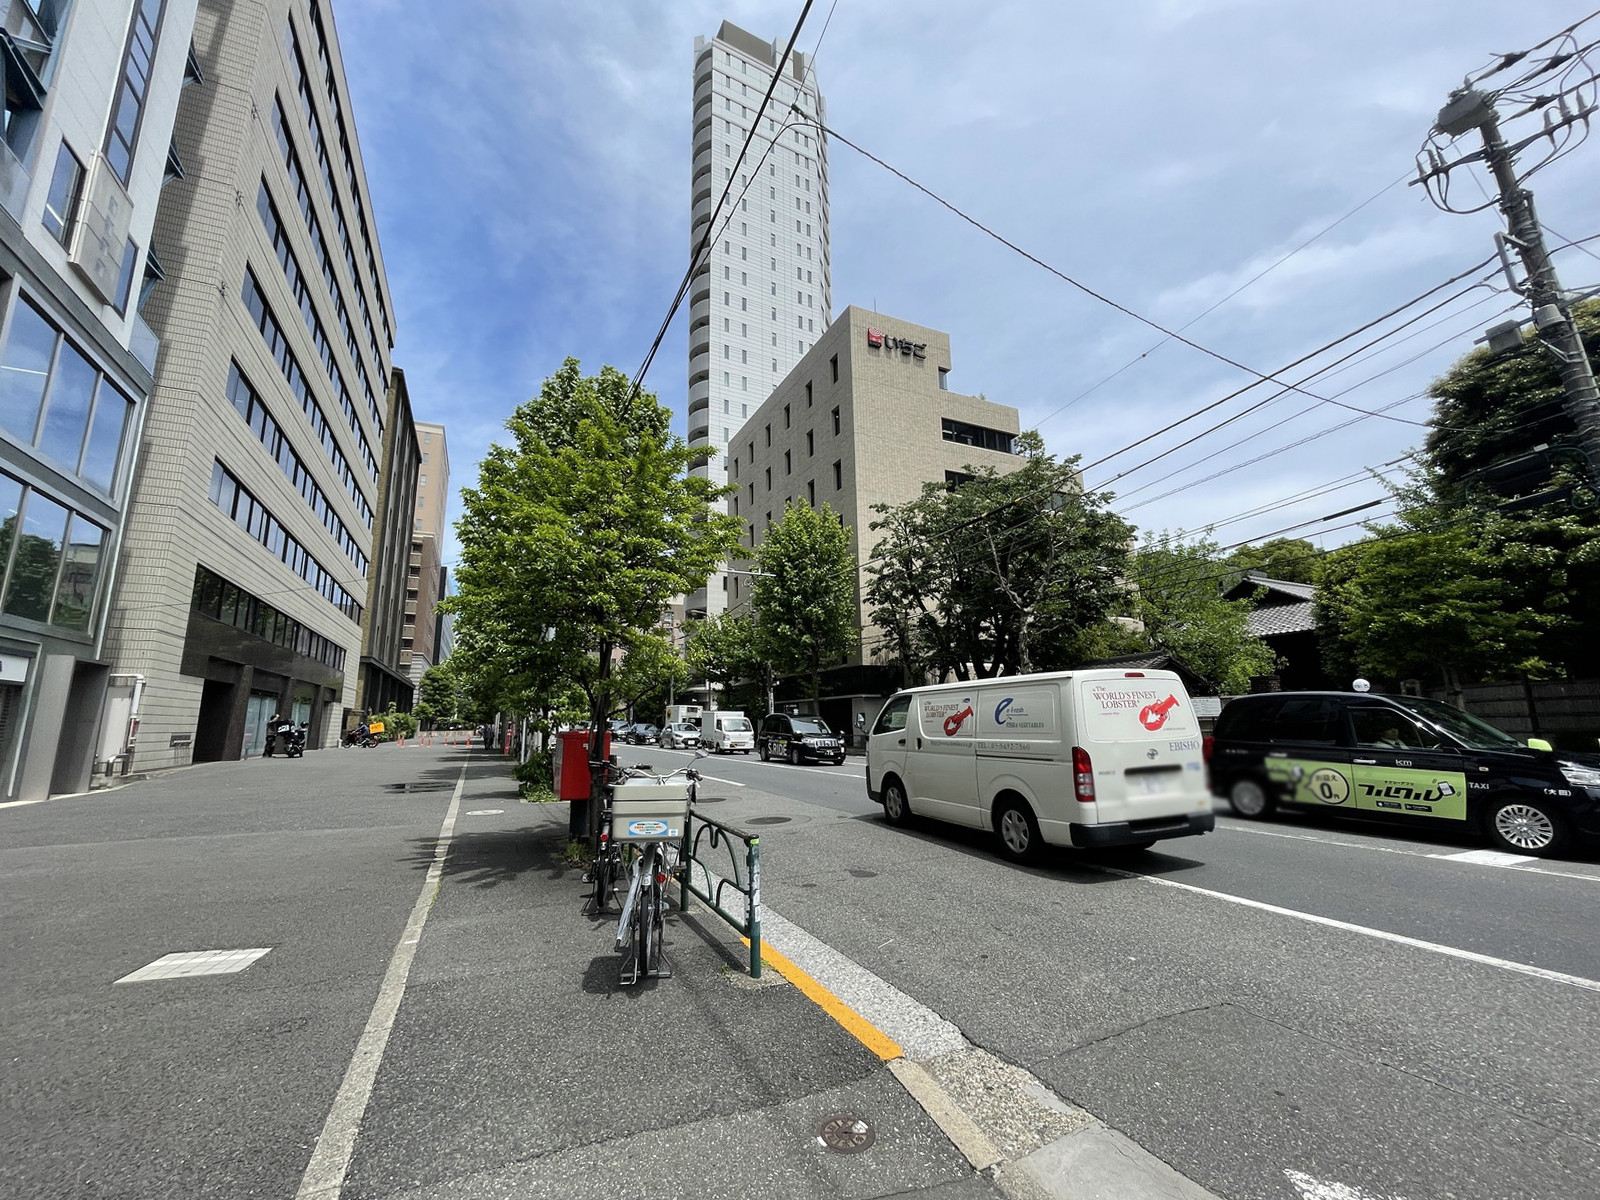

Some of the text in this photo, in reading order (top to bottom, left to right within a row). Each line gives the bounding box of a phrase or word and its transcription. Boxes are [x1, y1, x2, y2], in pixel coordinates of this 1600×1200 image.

[884, 334, 927, 360] いちご
[1092, 691, 1157, 701] WORLD'S FINEST
[1101, 700, 1138, 709] LOBSTER
[1169, 740, 1200, 752] EBISHO
[1468, 781, 1490, 790] TAXI
